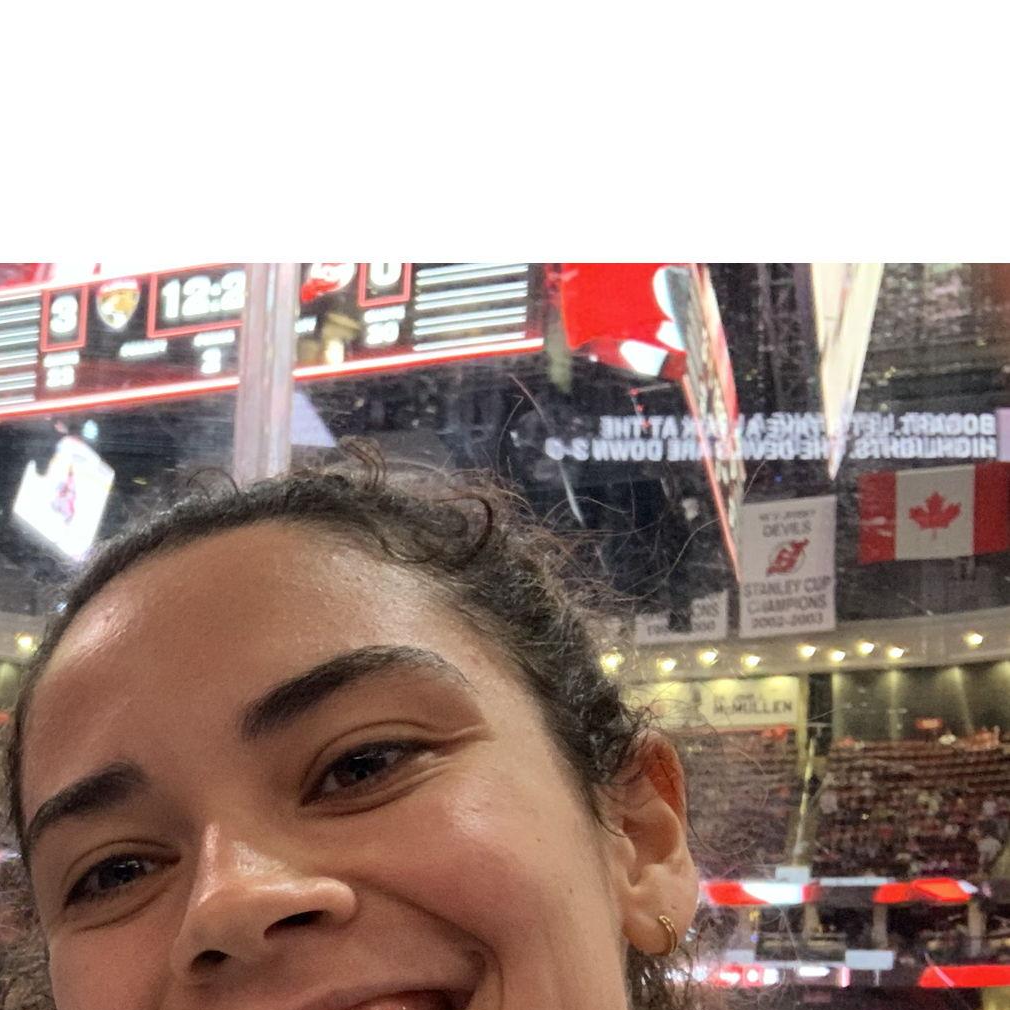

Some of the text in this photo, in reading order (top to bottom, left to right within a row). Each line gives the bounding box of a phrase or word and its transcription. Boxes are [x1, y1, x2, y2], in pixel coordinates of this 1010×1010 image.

[162, 271, 247, 319] 12:2
[50, 294, 79, 334] 3
[762, 520, 813, 538] DEVILS
[743, 578, 802, 598] STANLEY
[746, 593, 828, 615] CHAMPIONS
